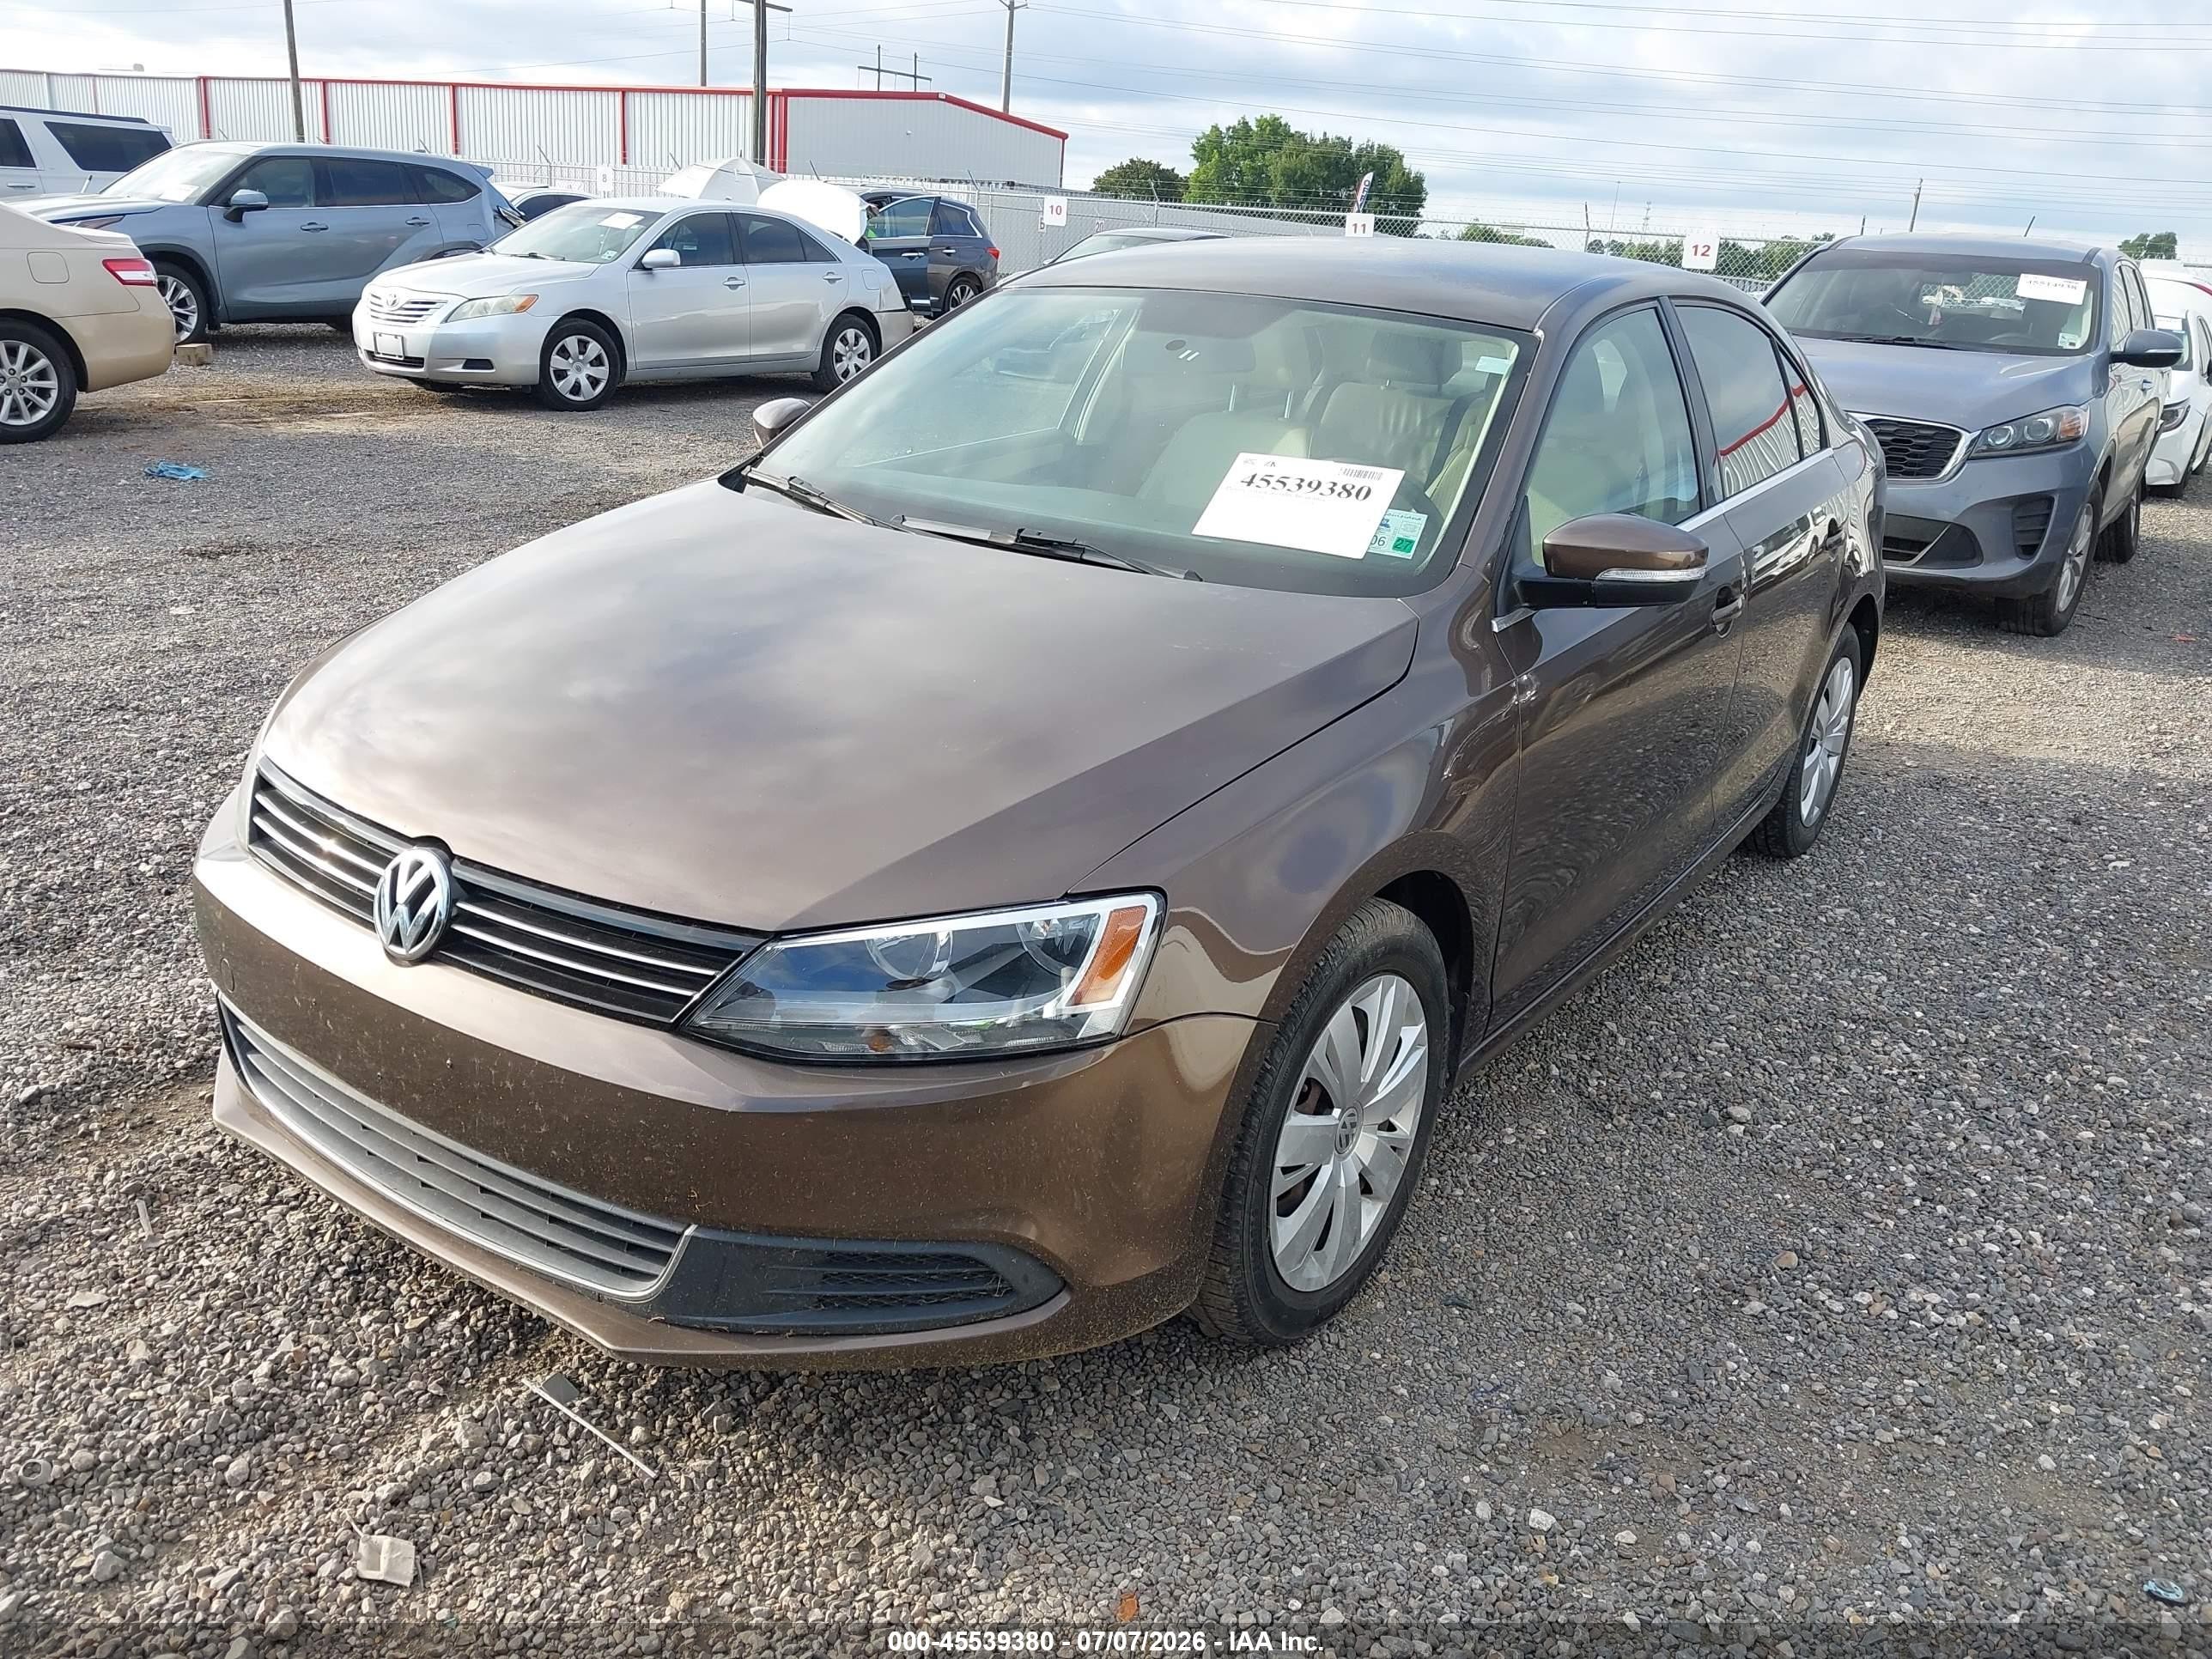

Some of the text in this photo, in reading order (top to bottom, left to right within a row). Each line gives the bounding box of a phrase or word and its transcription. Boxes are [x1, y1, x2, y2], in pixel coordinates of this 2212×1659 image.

[1049, 205, 1061, 215] 10
[1352, 223, 1366, 234] 11
[1692, 244, 1711, 257] 12
[1240, 472, 1372, 501] 45539380
[1393, 538, 1413, 550] 27
[378, 854, 445, 956] VW
